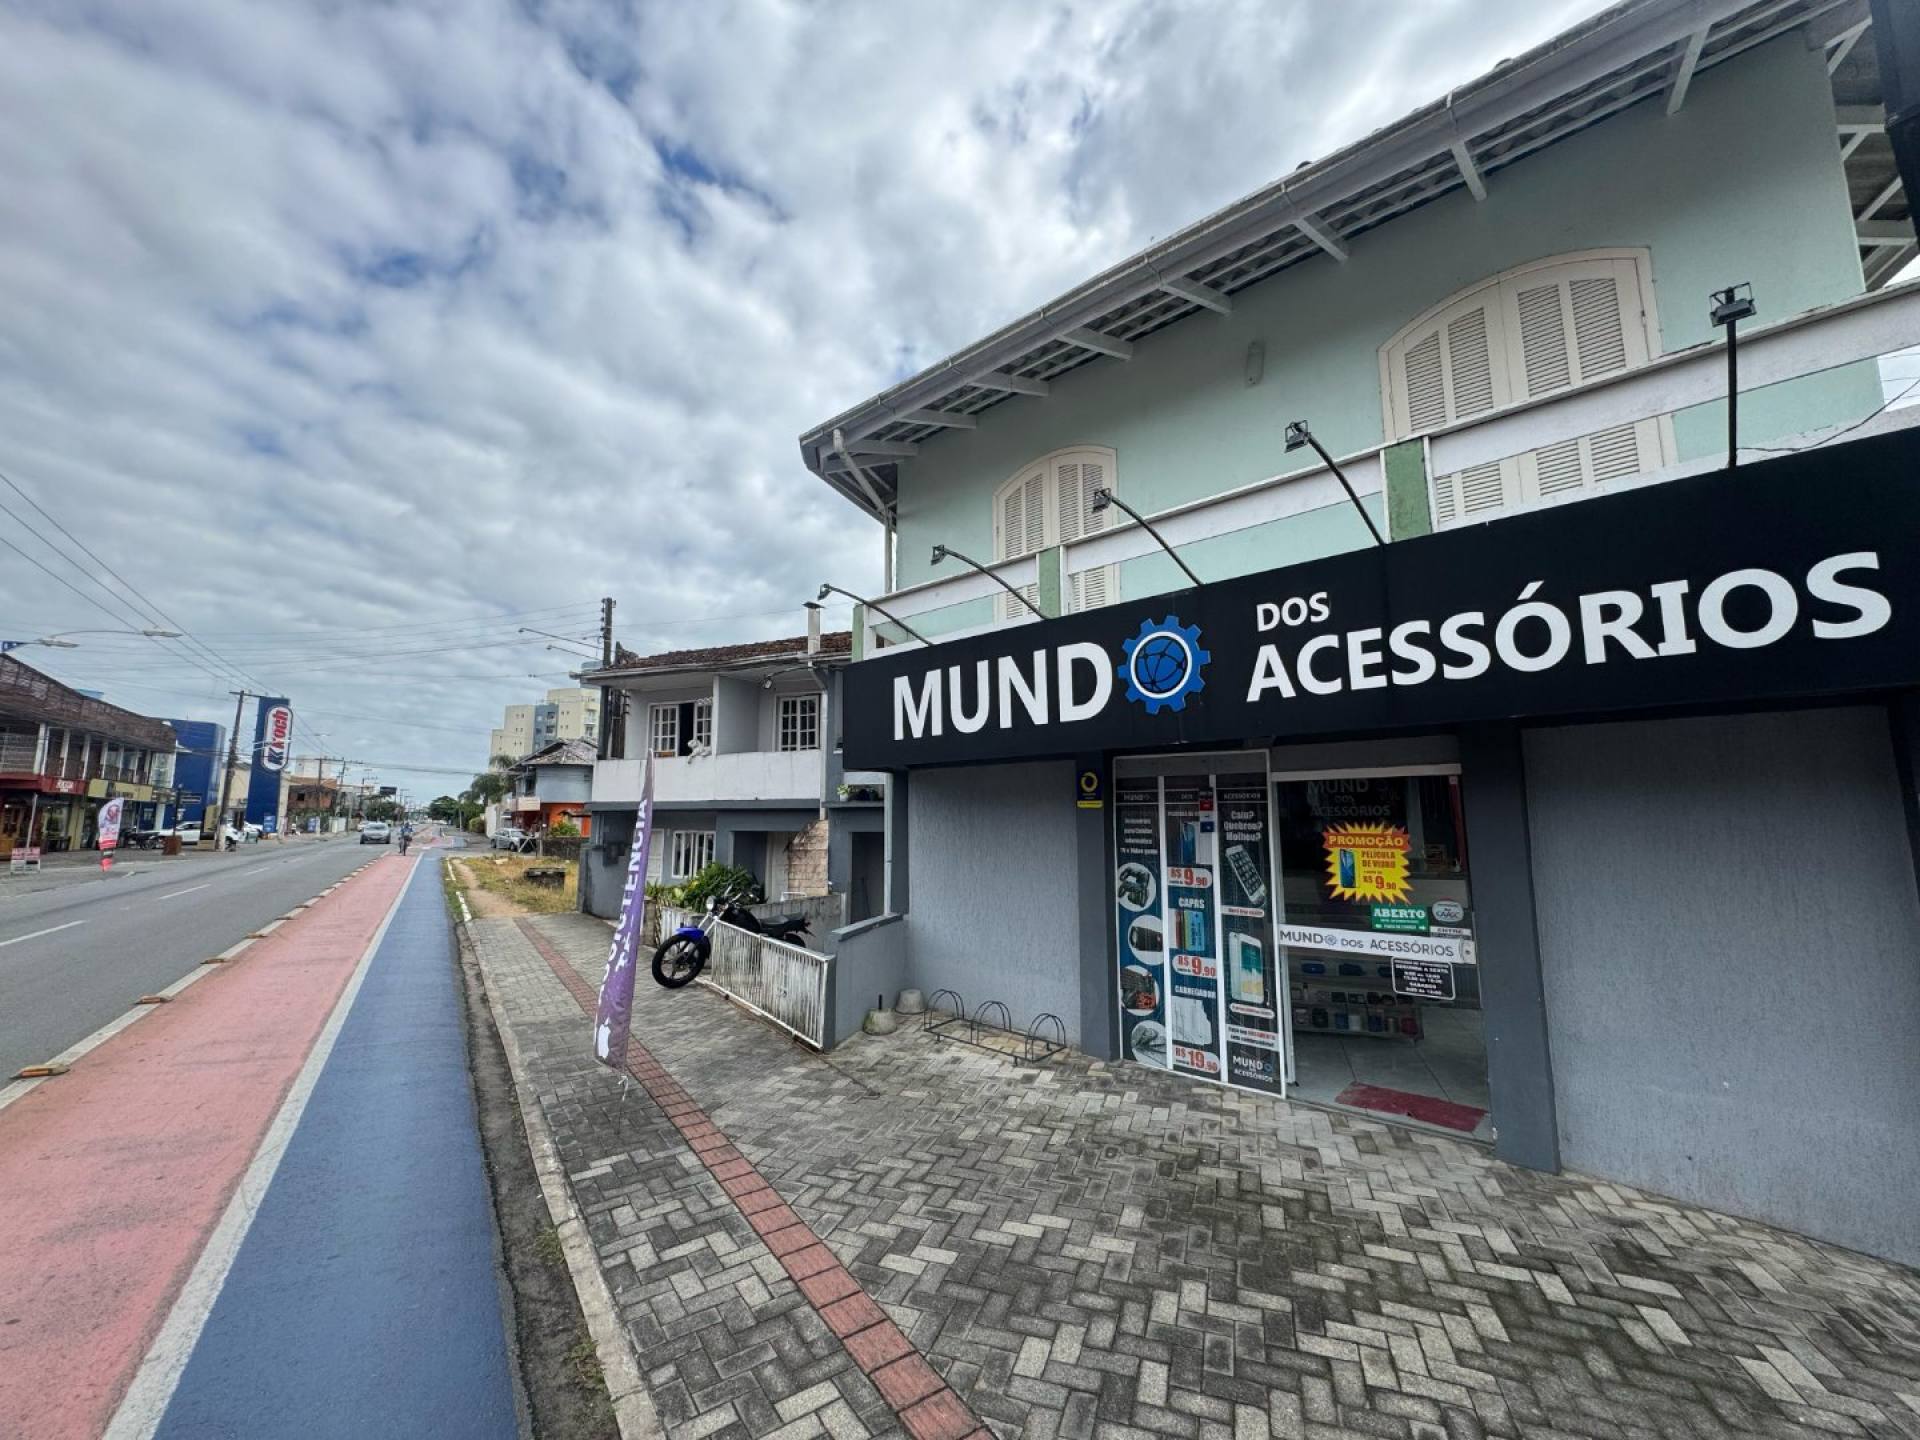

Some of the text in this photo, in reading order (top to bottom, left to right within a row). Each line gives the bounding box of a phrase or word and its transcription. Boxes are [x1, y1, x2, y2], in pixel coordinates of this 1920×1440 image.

[1256, 591, 1330, 632] DOS
[1245, 551, 1892, 702] ACESSÓRIOS
[1327, 834, 1404, 847] PROMOÇÃO
[1373, 907, 1427, 919] ABERTO
[1340, 938, 1364, 949] DOS
[1370, 938, 1455, 957] ACESSÓRIOS
